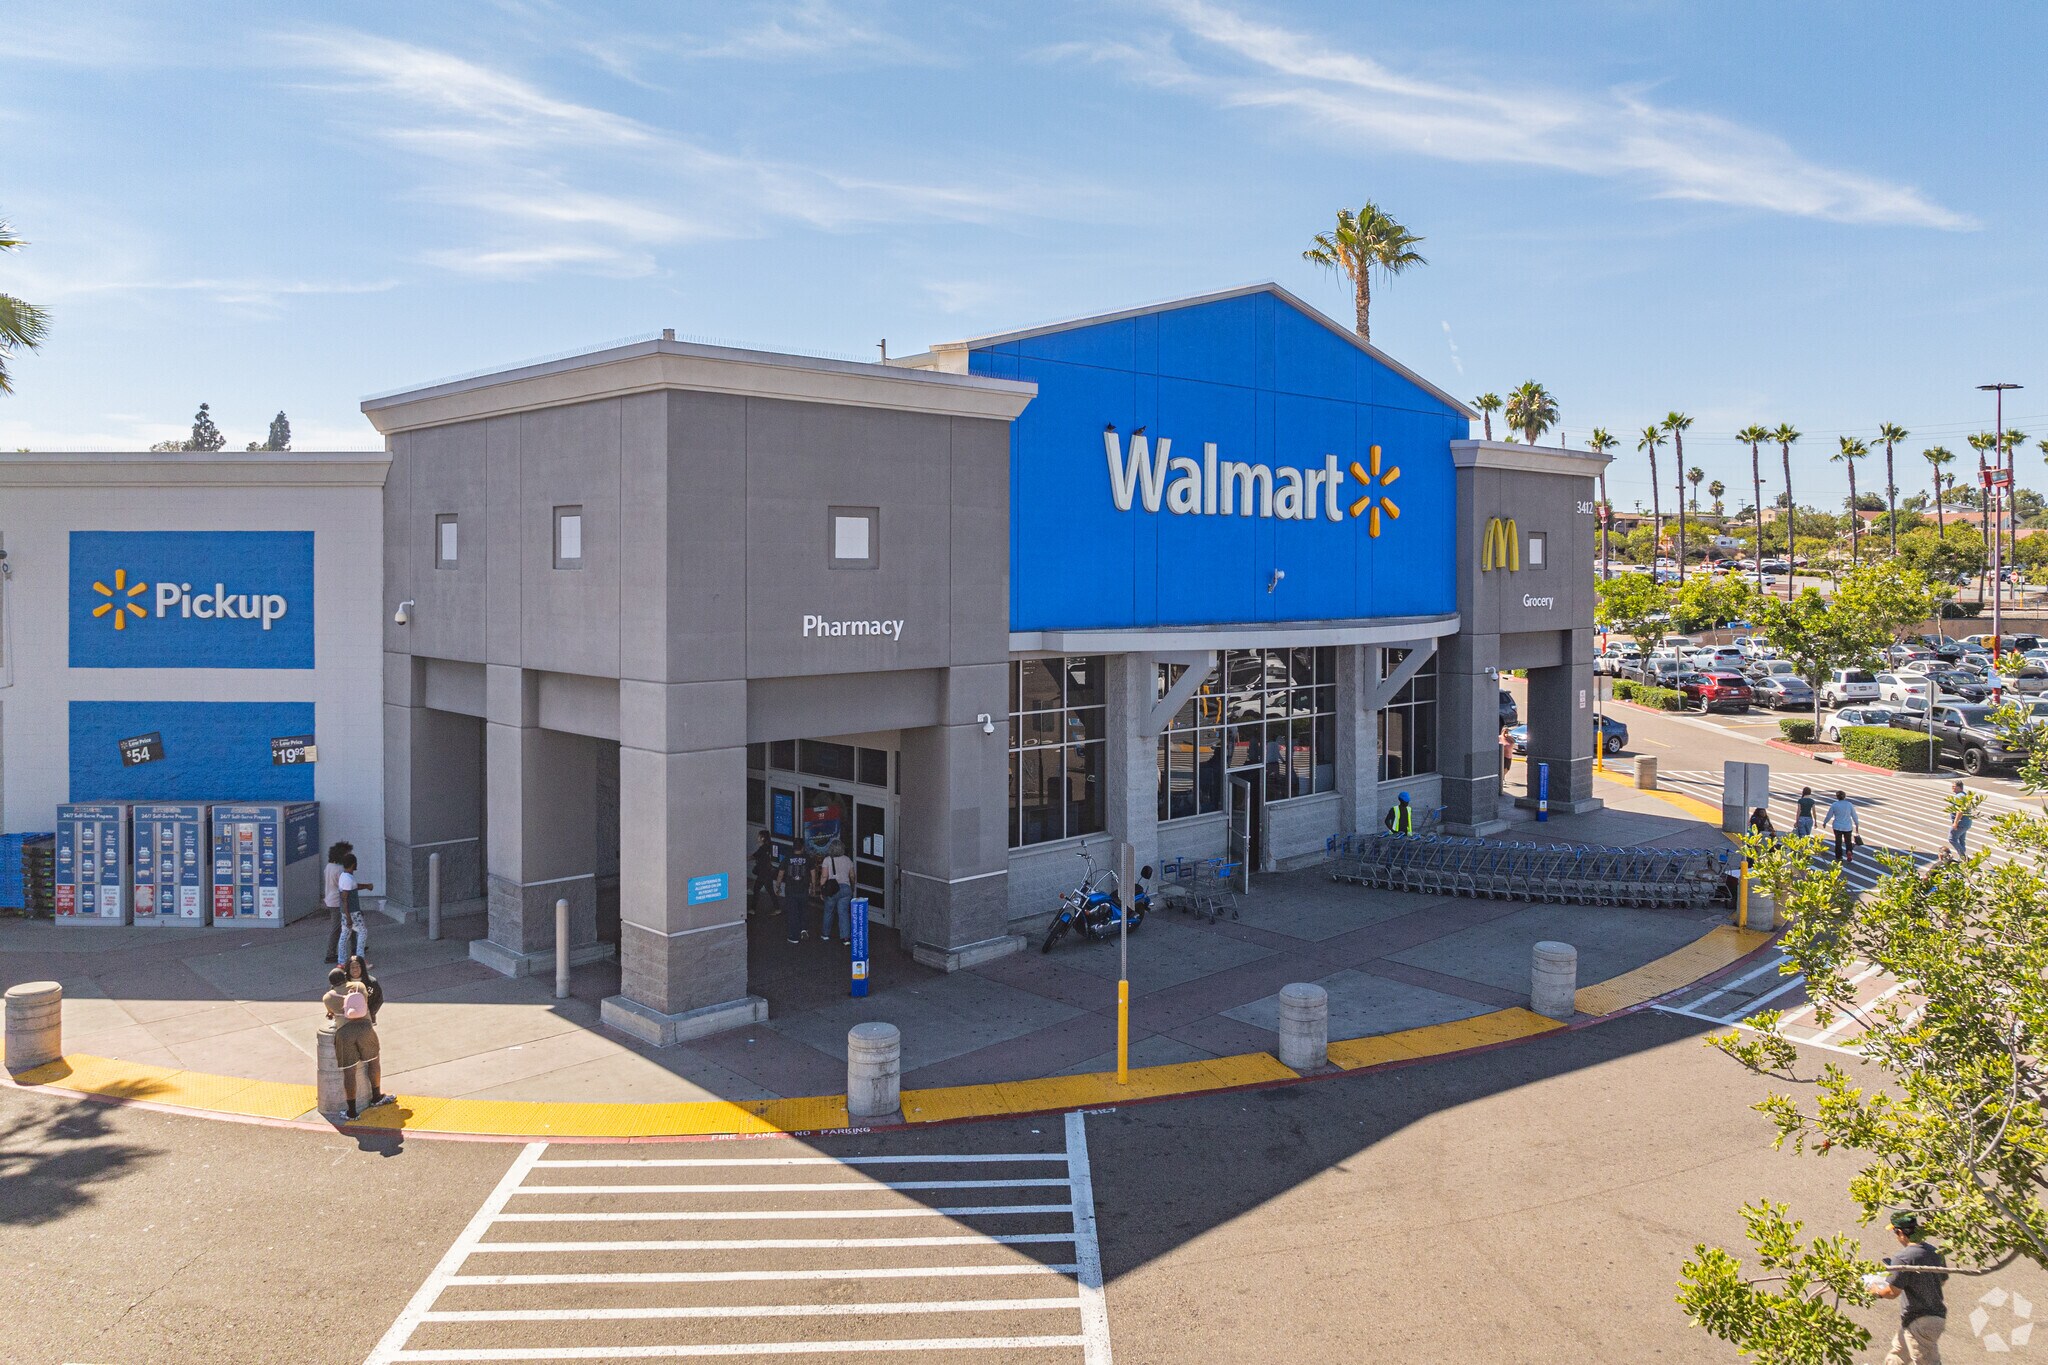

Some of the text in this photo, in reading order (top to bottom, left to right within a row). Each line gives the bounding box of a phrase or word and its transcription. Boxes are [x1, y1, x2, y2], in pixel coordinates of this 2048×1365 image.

[1103, 431, 1344, 522] Walmart
[1576, 501, 1594, 514] 3412
[156, 582, 288, 630] Pickup
[1522, 593, 1554, 610] Grocery
[802, 615, 904, 641] Pharmacy
[821, 1127, 871, 1135] PARKING
